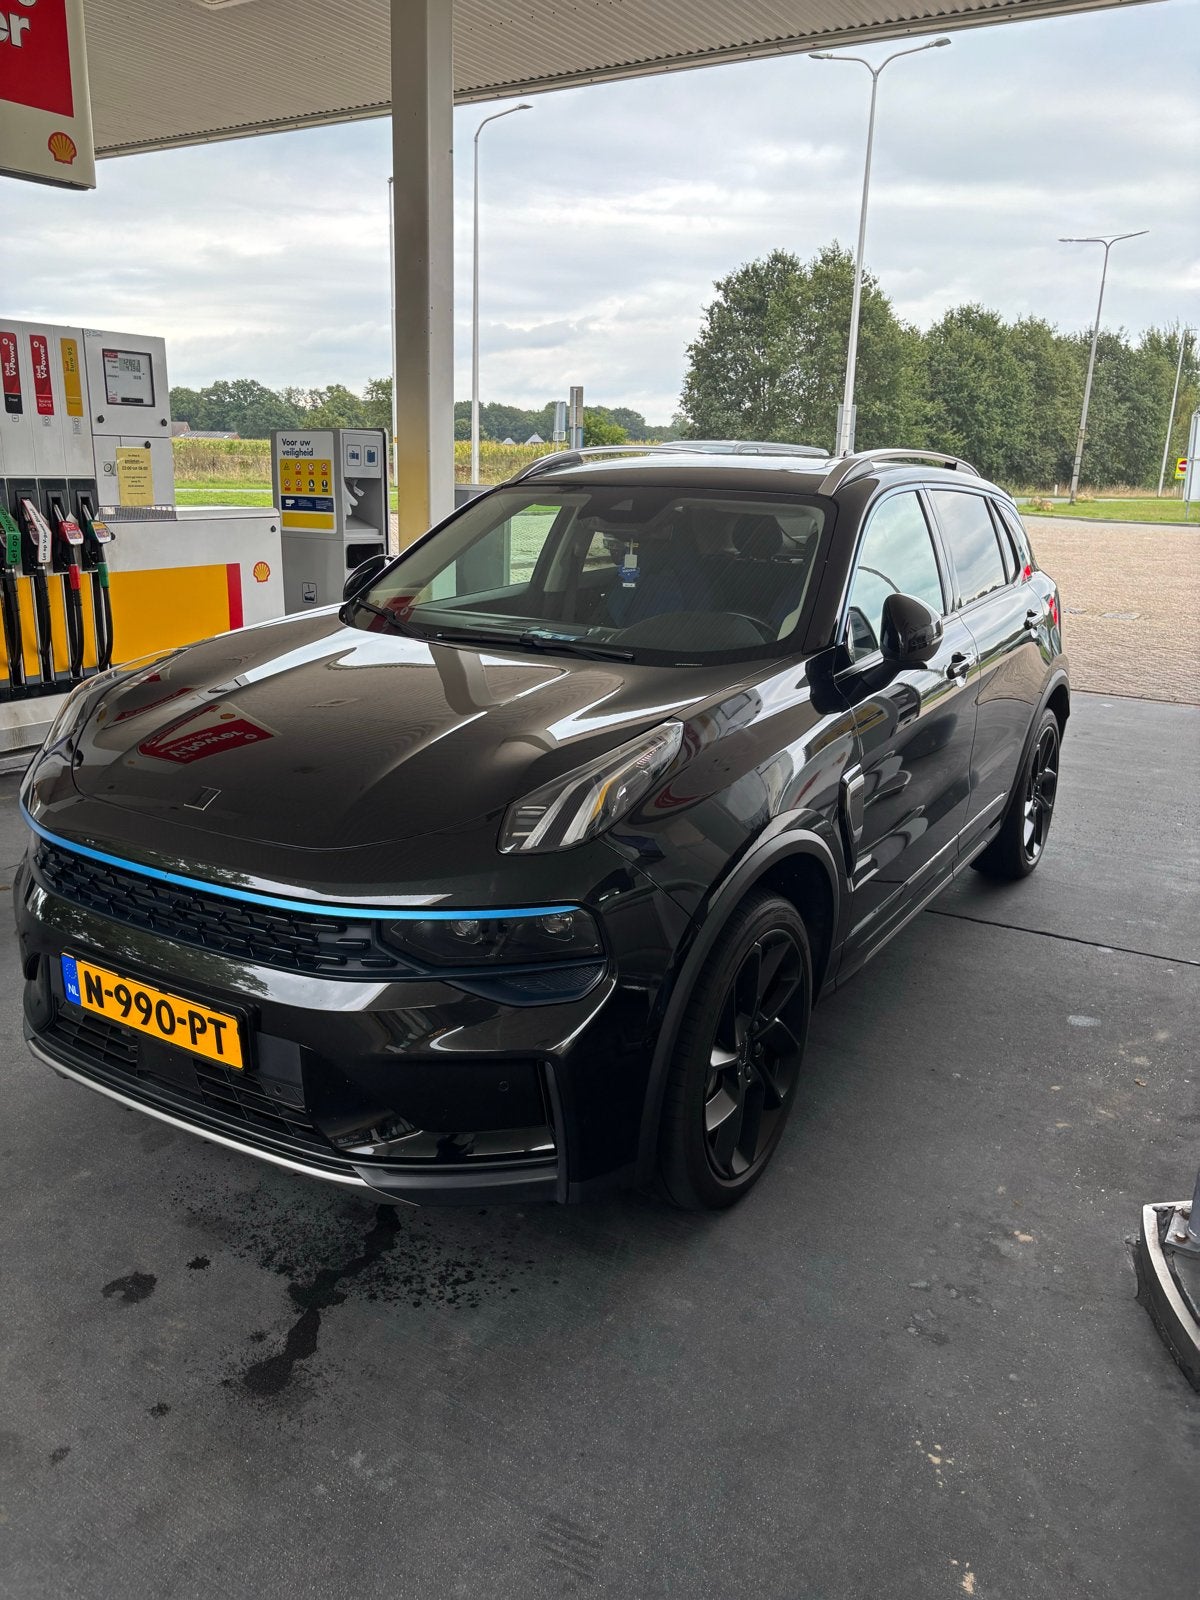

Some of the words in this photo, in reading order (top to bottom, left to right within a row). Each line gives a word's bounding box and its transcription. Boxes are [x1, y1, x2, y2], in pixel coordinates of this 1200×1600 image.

[9, 341, 17, 376] V-Power
[40, 344, 48, 379] V-Power
[281, 438, 297, 447] Voor
[282, 448, 314, 458] veiligheid
[12, 535, 19, 547] op
[10, 549, 18, 563] Let
[68, 983, 79, 997] NL
[84, 970, 227, 1055] N-990-PT
